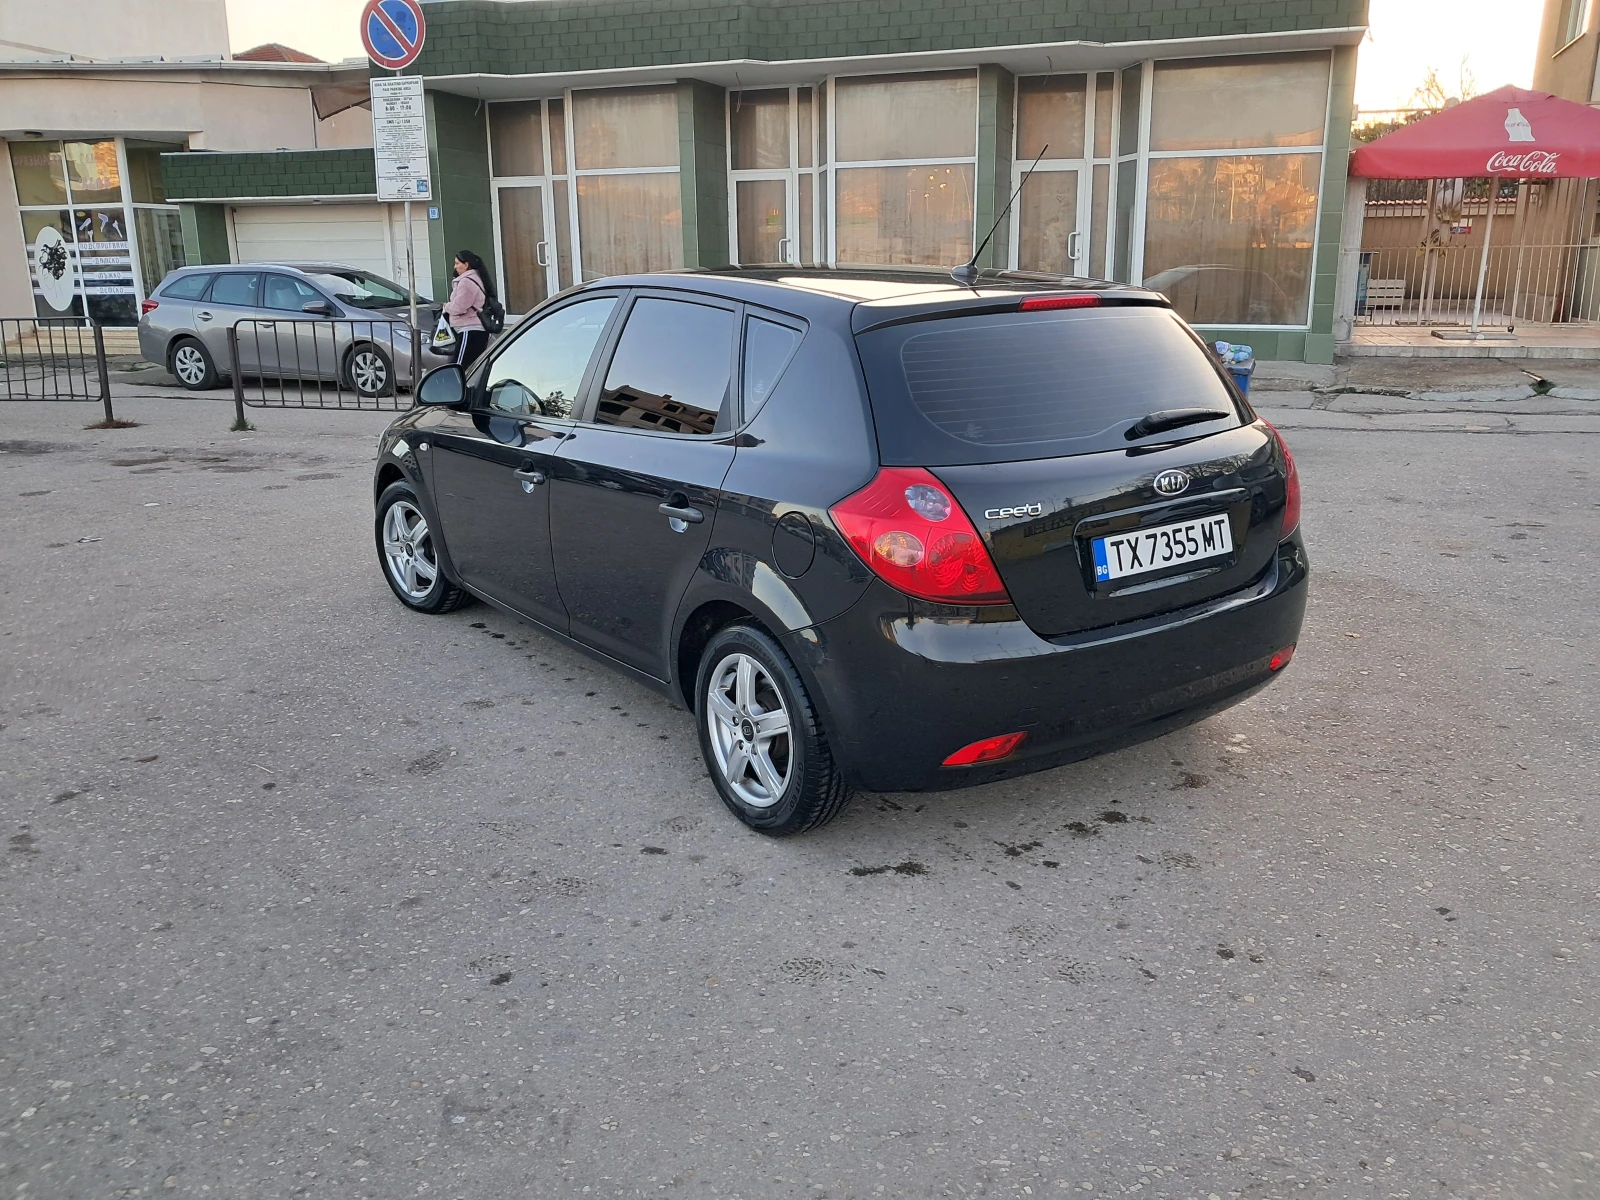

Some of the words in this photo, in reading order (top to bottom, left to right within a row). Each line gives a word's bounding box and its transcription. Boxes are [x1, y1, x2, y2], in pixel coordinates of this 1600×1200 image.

[1486, 150, 1561, 172] Coca-Cola
[1160, 475, 1186, 492] KIA
[1097, 565, 1108, 576] BG
